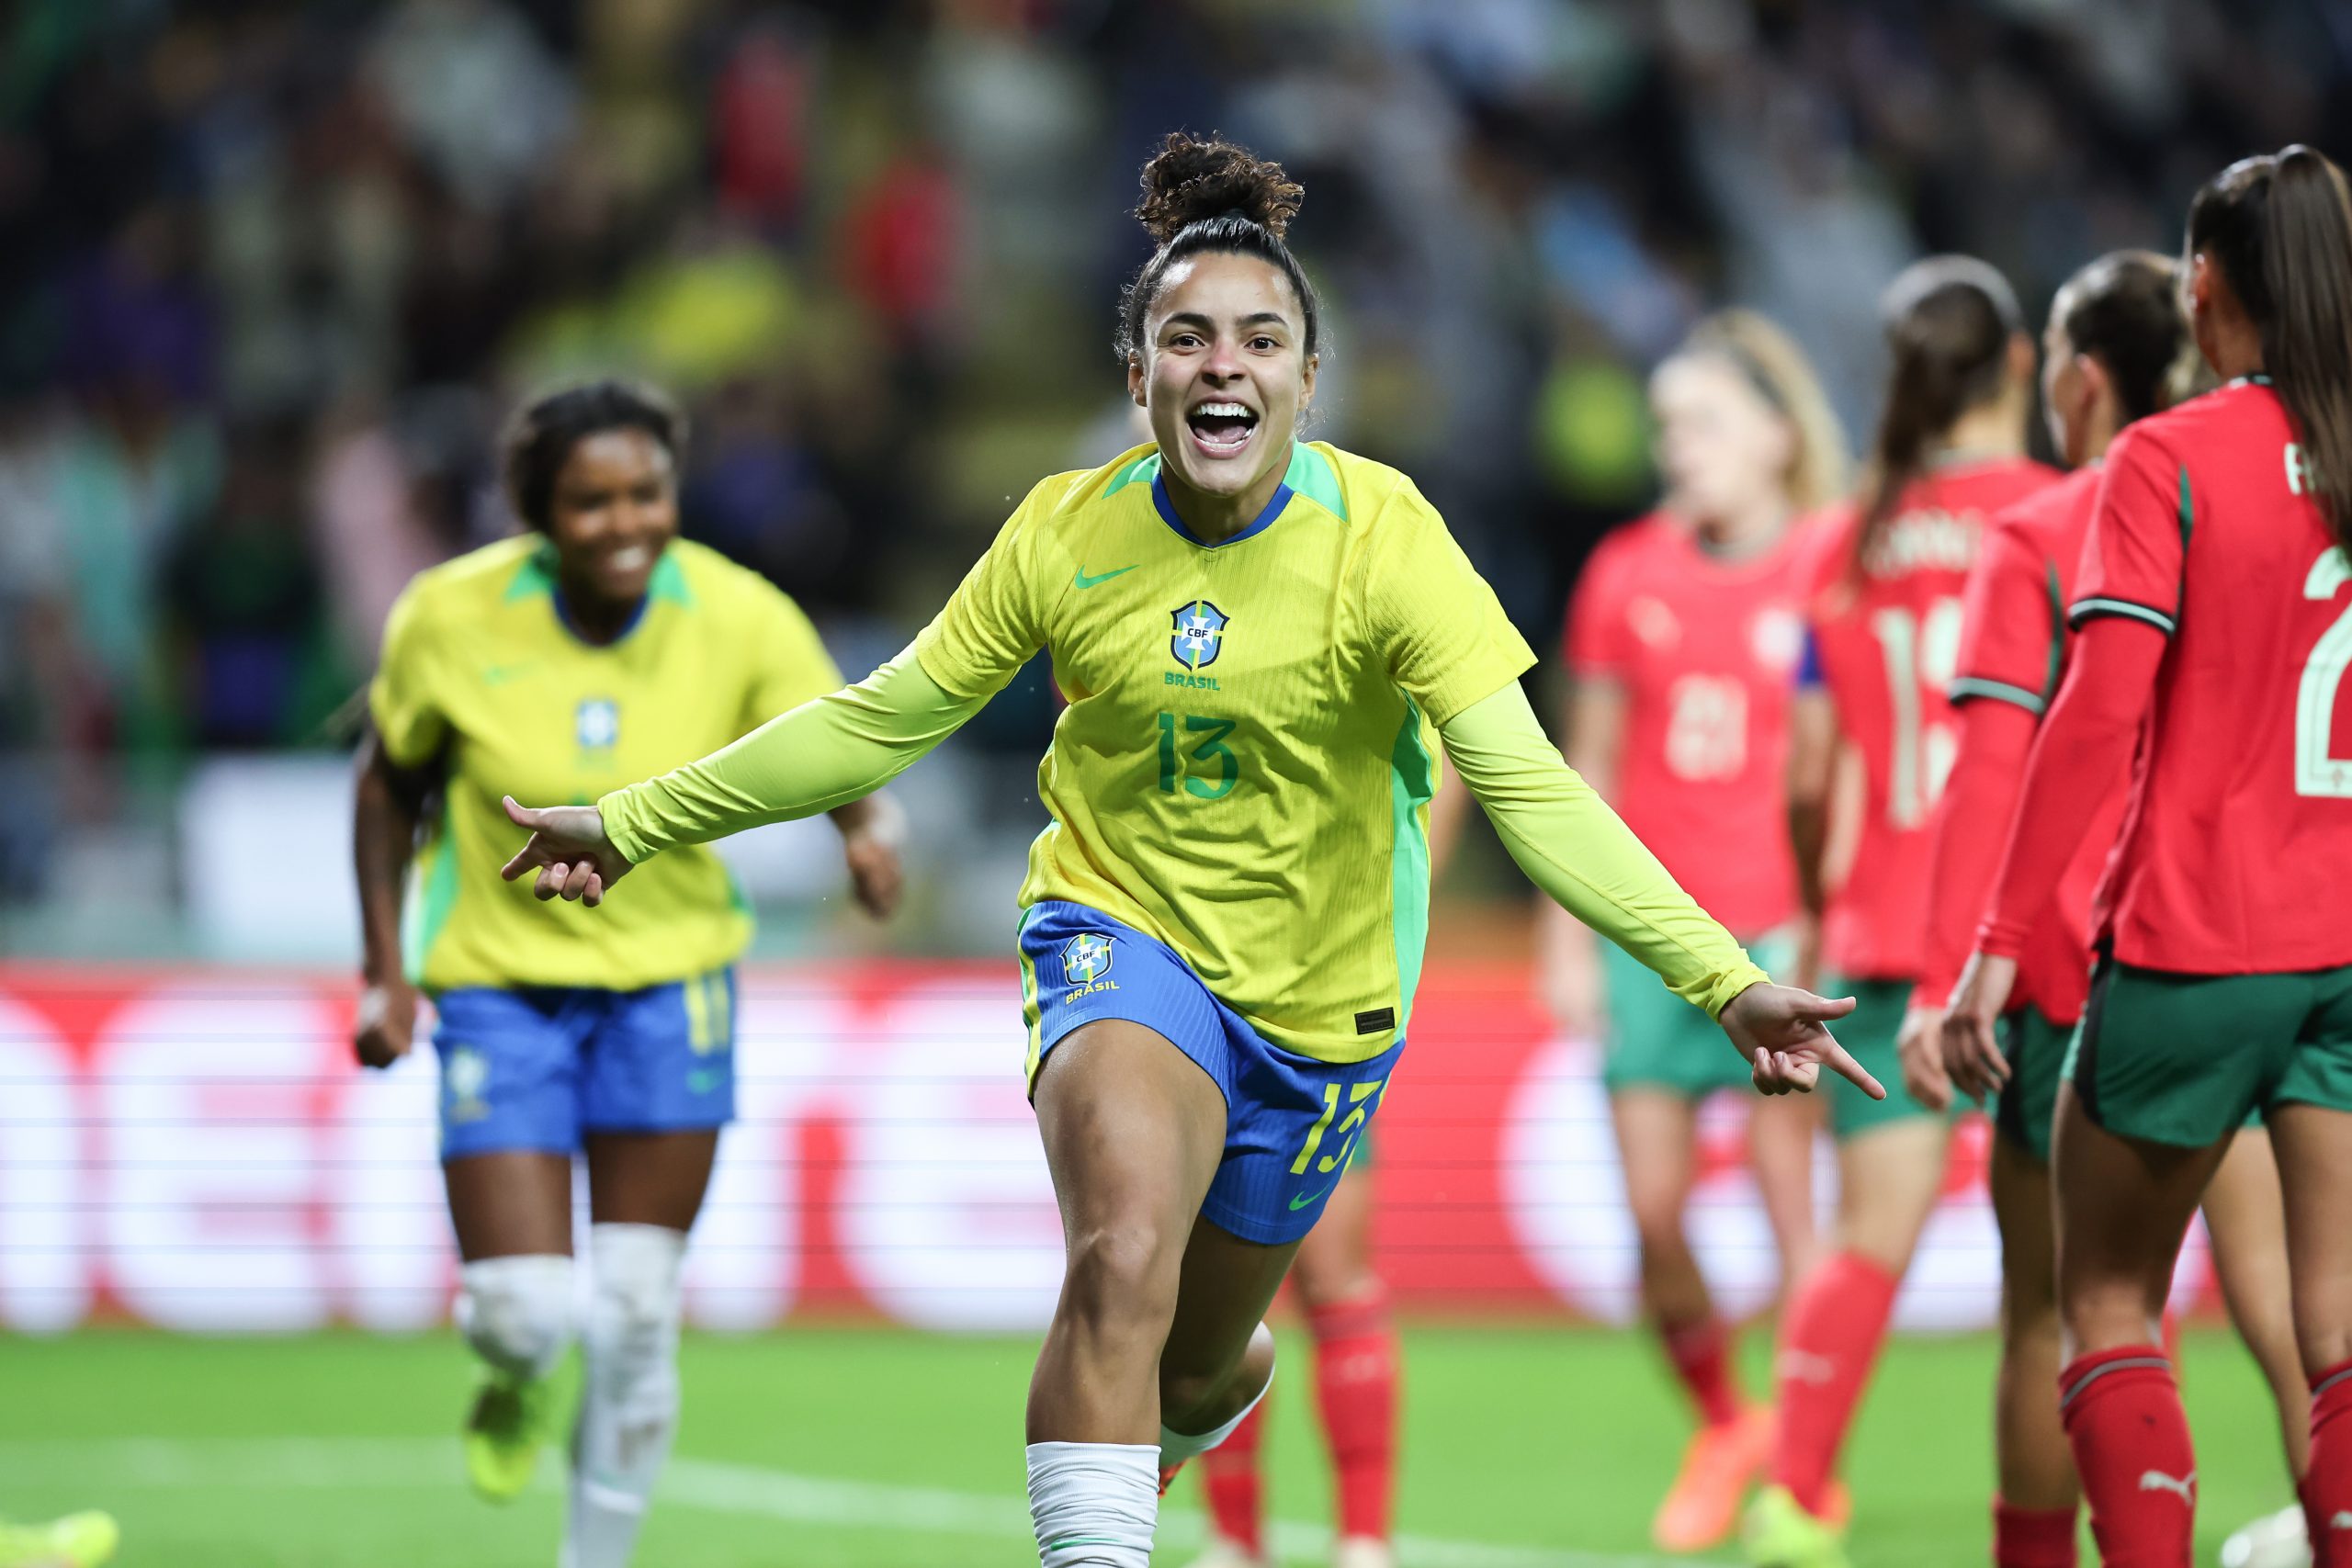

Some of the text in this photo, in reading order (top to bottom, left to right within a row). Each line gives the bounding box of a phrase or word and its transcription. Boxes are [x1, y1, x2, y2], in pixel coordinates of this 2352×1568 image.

[1187, 627, 1209, 638] CBF
[1164, 671, 1221, 692] BRASIL
[1158, 712, 1239, 800] 13
[1076, 950, 1096, 963] CBF
[1066, 980, 1121, 1005] BRASIL
[1289, 1079, 1383, 1175] 13
